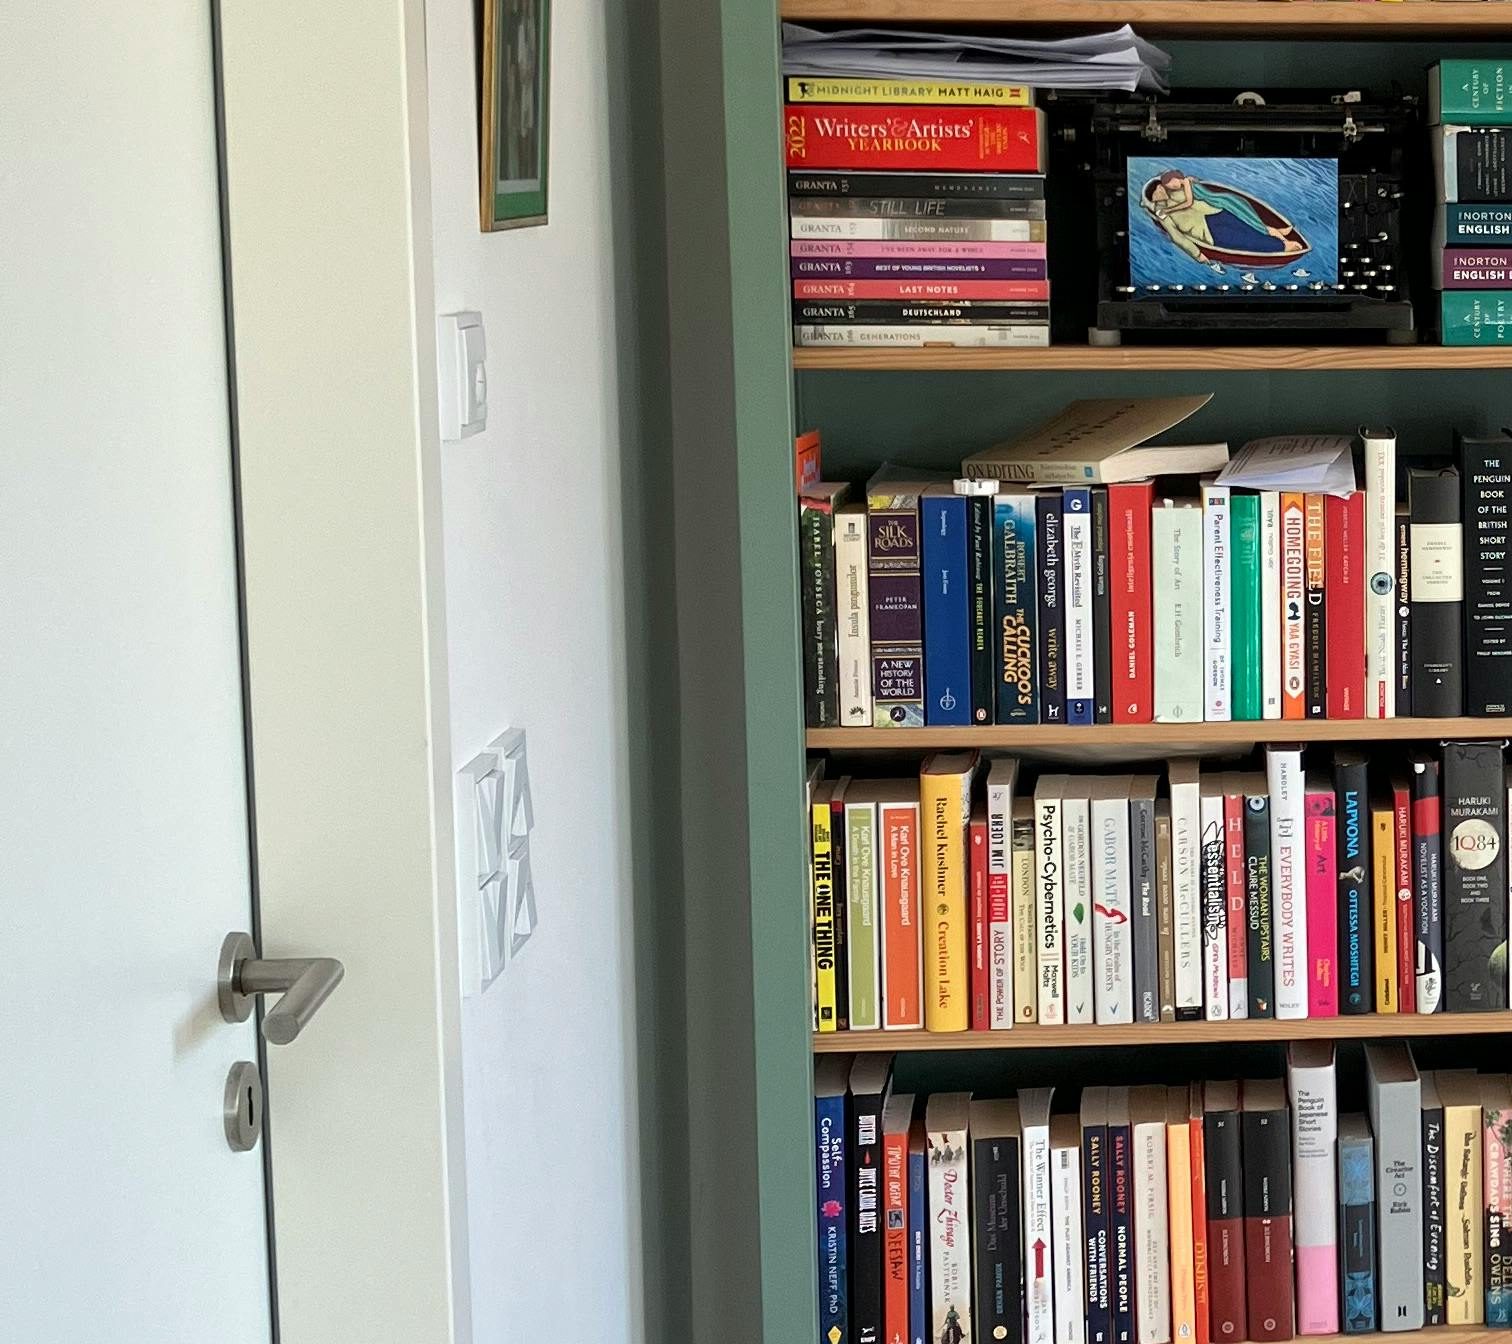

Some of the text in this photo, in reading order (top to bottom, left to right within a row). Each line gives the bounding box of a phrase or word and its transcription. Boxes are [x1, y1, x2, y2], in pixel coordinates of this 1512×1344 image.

[816, 85, 1004, 98] MIDNIGHT LIBRARY MATT HAIG
[789, 115, 805, 158] 2022
[848, 138, 942, 152] YEARBOOK
[1458, 224, 1510, 235] ENGLISH
[1464, 212, 1512, 221] NORTON
[800, 262, 842, 273] GRANTA
[1453, 270, 1505, 280] ENGLISH
[1459, 257, 1508, 266] NORTON
[803, 284, 845, 294] GRANTA
[900, 285, 958, 294] LAST NOTES
[803, 307, 845, 317] GRANTA
[903, 308, 962, 317] DEUTSCHLAND
[967, 464, 1035, 479] ON EDITING
[1004, 519, 1016, 604] GALBRAITH
[1017, 542, 1025, 583] ROBERT
[1045, 513, 1058, 608] elizabeth george
[1398, 547, 1410, 604] hemingway
[812, 517, 826, 694] ISABEL FONSECA bury me standing
[1286, 517, 1301, 670] HOMEGOING YAA GYASI
[891, 661, 914, 669] NEW
[1003, 615, 1017, 683] CALLING
[1017, 625, 1032, 705] CUCKOO'S
[1046, 628, 1058, 690] write away
[880, 670, 912, 678] HISTORY
[880, 679, 895, 687] OF
[880, 688, 915, 696] WORLD
[815, 851, 831, 881] THE
[1206, 843, 1221, 926] essentialism
[816, 884, 832, 917] ONE
[935, 797, 950, 1009] Rachel Kushner Creation Lake
[1039, 805, 1059, 999] Psycho-Cybernetics Maxwell
[1248, 856, 1259, 930] CLAIRE MESSUD
[1345, 791, 1359, 986] LAPVONA OTTESSA MOSHFEGH
[1258, 856, 1270, 961] THE WOMAN UPSTAIRS
[1280, 846, 1295, 987] EVERYBODY WRITES
[818, 920, 833, 970] THING
[1042, 965, 1051, 988] Maltz
[819, 1117, 833, 1188] Compassion
[831, 1137, 842, 1167] Self-
[937, 1169, 959, 1248] Doctor Zhivago
[1115, 1136, 1128, 1313] SALLY ROONEY NORMAL PEOPLE
[827, 1226, 837, 1264] KRISTIN
[829, 1294, 839, 1314] PhD
